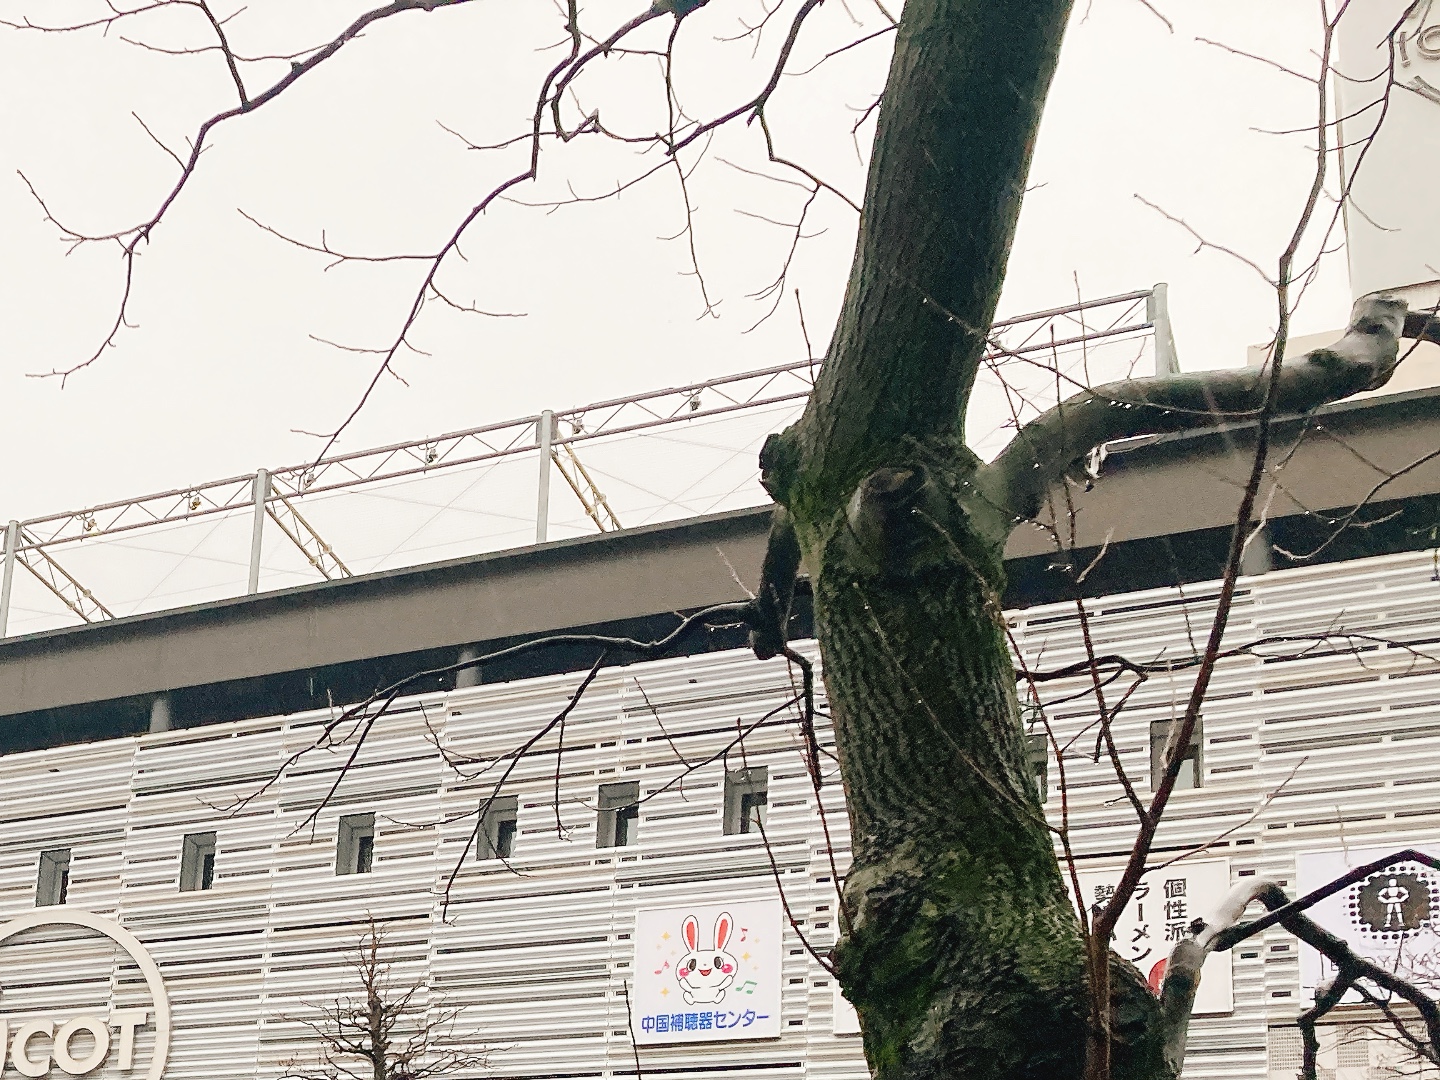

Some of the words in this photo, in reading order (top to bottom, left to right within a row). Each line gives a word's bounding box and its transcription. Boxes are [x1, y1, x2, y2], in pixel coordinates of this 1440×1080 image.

[1131, 881, 1152, 963] ラーメン
[1163, 877, 1188, 942] 個性派
[640, 1008, 770, 1034] 中国補聴器センター
